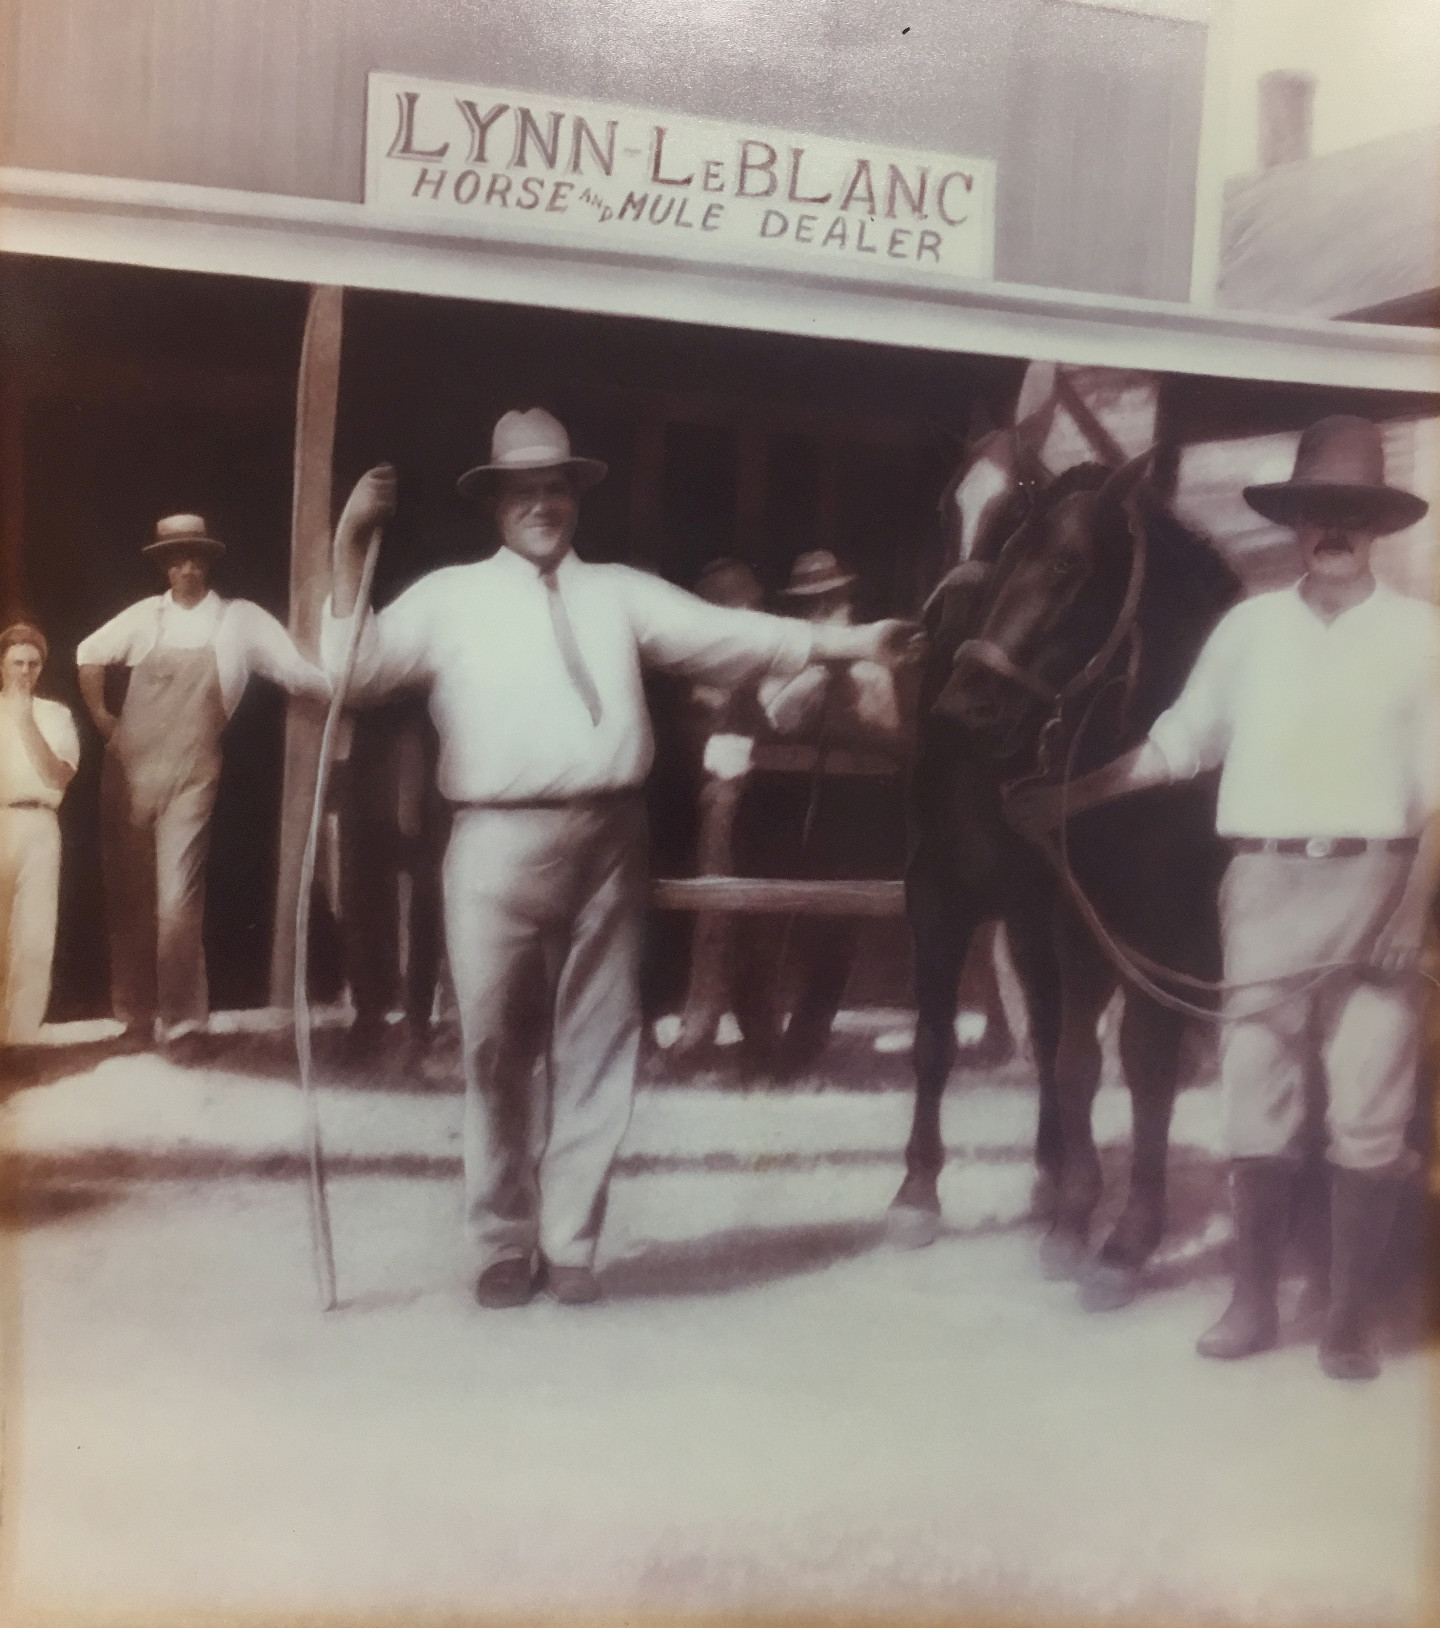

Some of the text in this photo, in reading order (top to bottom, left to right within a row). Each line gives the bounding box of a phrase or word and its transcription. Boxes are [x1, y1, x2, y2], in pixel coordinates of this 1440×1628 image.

[411, 167, 943, 264] HORSE AND MULE DEALER
